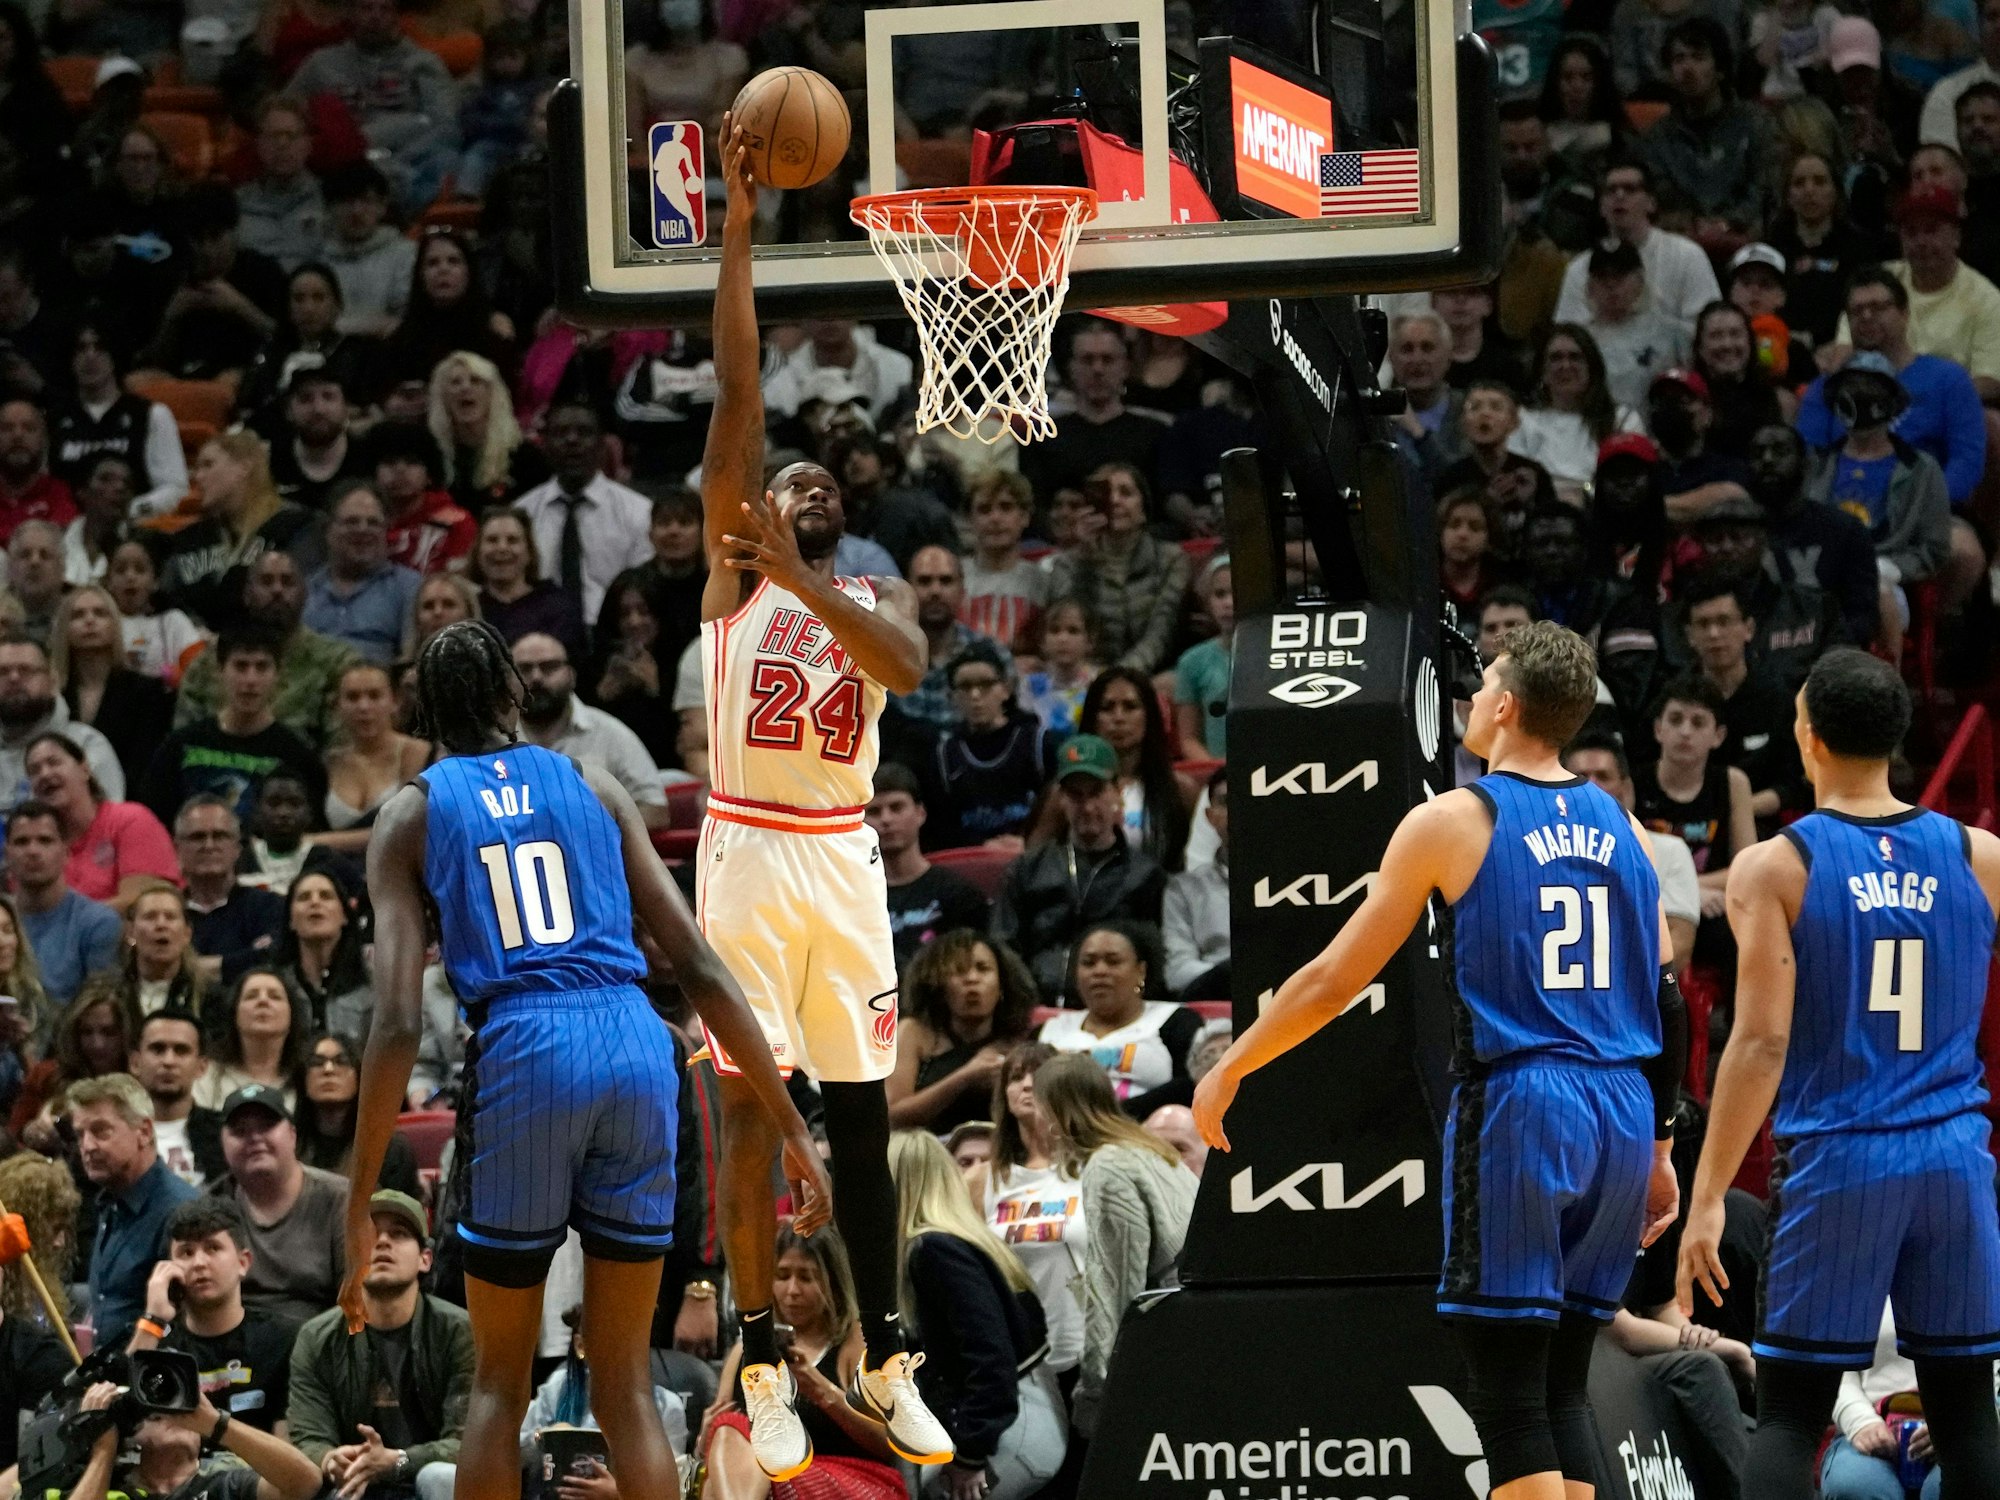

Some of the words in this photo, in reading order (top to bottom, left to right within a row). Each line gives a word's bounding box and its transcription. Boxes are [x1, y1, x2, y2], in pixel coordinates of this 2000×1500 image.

[1242, 102, 1325, 186] AMERANT
[660, 219, 687, 239] NBA
[1283, 328, 1331, 413] socios.com
[1271, 611, 1367, 649] BIO
[1269, 650, 1365, 669] STEEL
[746, 659, 865, 766] 24
[479, 784, 534, 819] BOL
[1251, 760, 1379, 797] KIA
[1523, 823, 1616, 867] WAGNER
[479, 841, 575, 950] 10
[1848, 871, 1938, 913] SUGGS
[1539, 886, 1611, 989] 21
[1868, 938, 1924, 1051] 4
[1230, 1159, 1426, 1214] KIA
[1139, 1427, 1412, 1481] American
